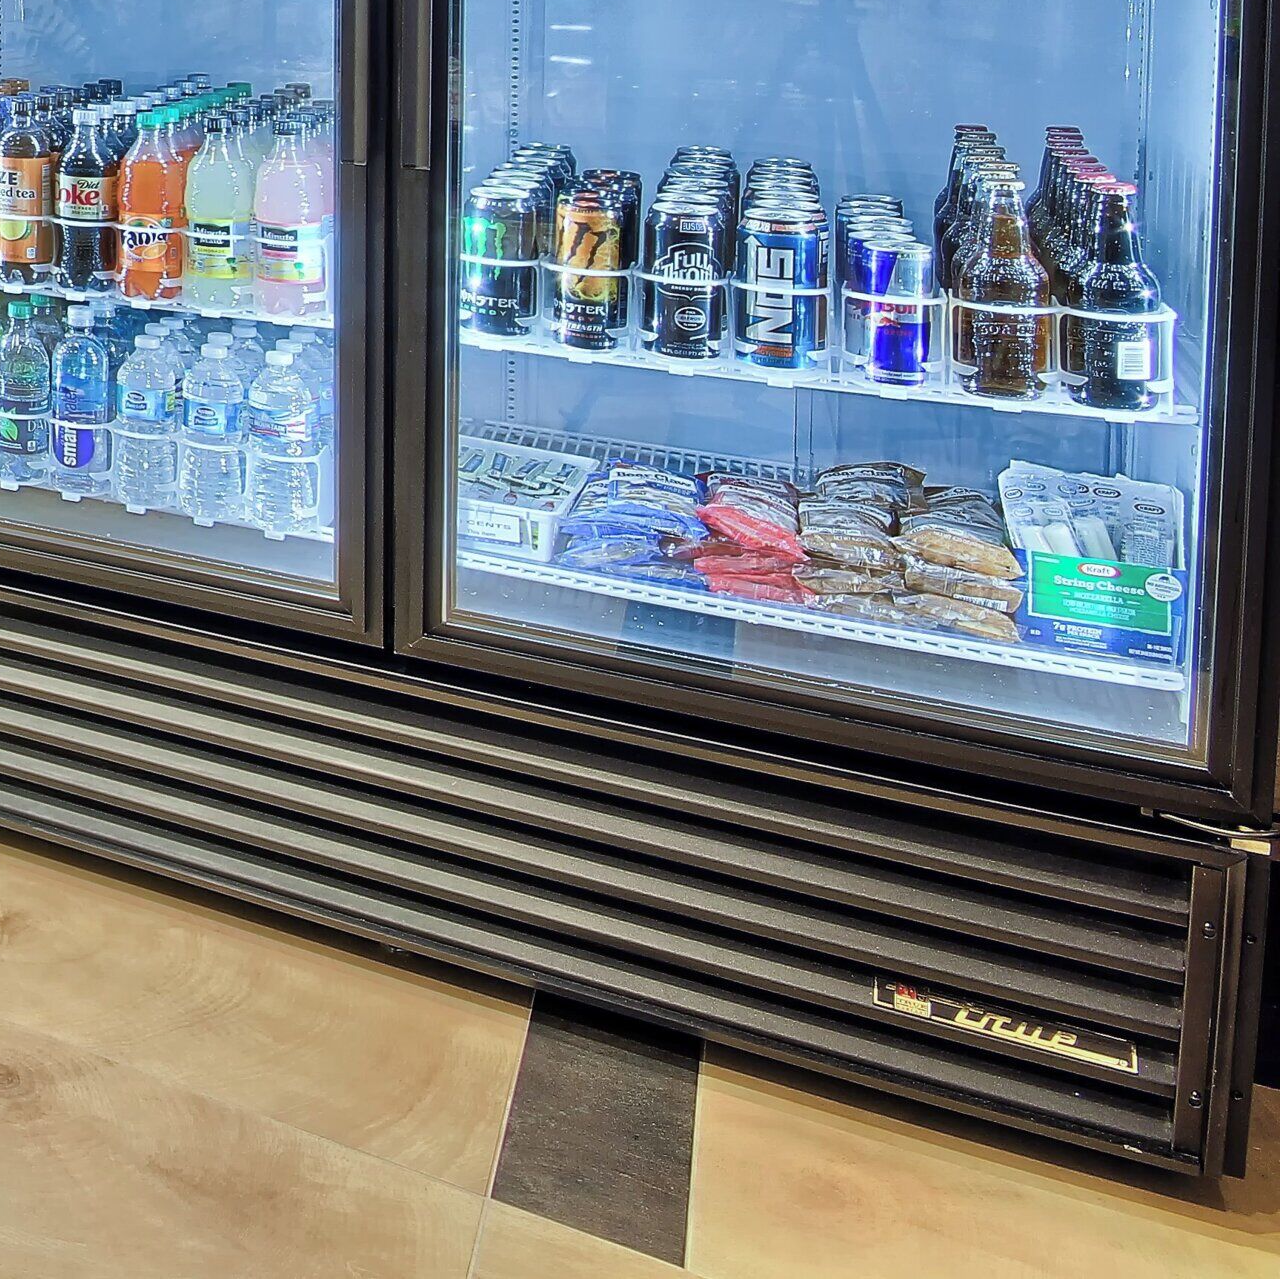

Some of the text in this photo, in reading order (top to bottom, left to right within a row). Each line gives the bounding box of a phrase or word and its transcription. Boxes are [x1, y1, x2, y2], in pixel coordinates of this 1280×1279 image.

[76, 179, 100, 189] Diet
[15, 189, 36, 199] tea
[673, 249, 709, 271] Full
[745, 246, 795, 345] NOS
[553, 298, 606, 316] ONSTER
[1096, 488, 1118, 497] KRAFT
[1139, 505, 1162, 513] KRAFT
[1085, 565, 1111, 576] Kraft
[1053, 575, 1146, 596] String Cheese
